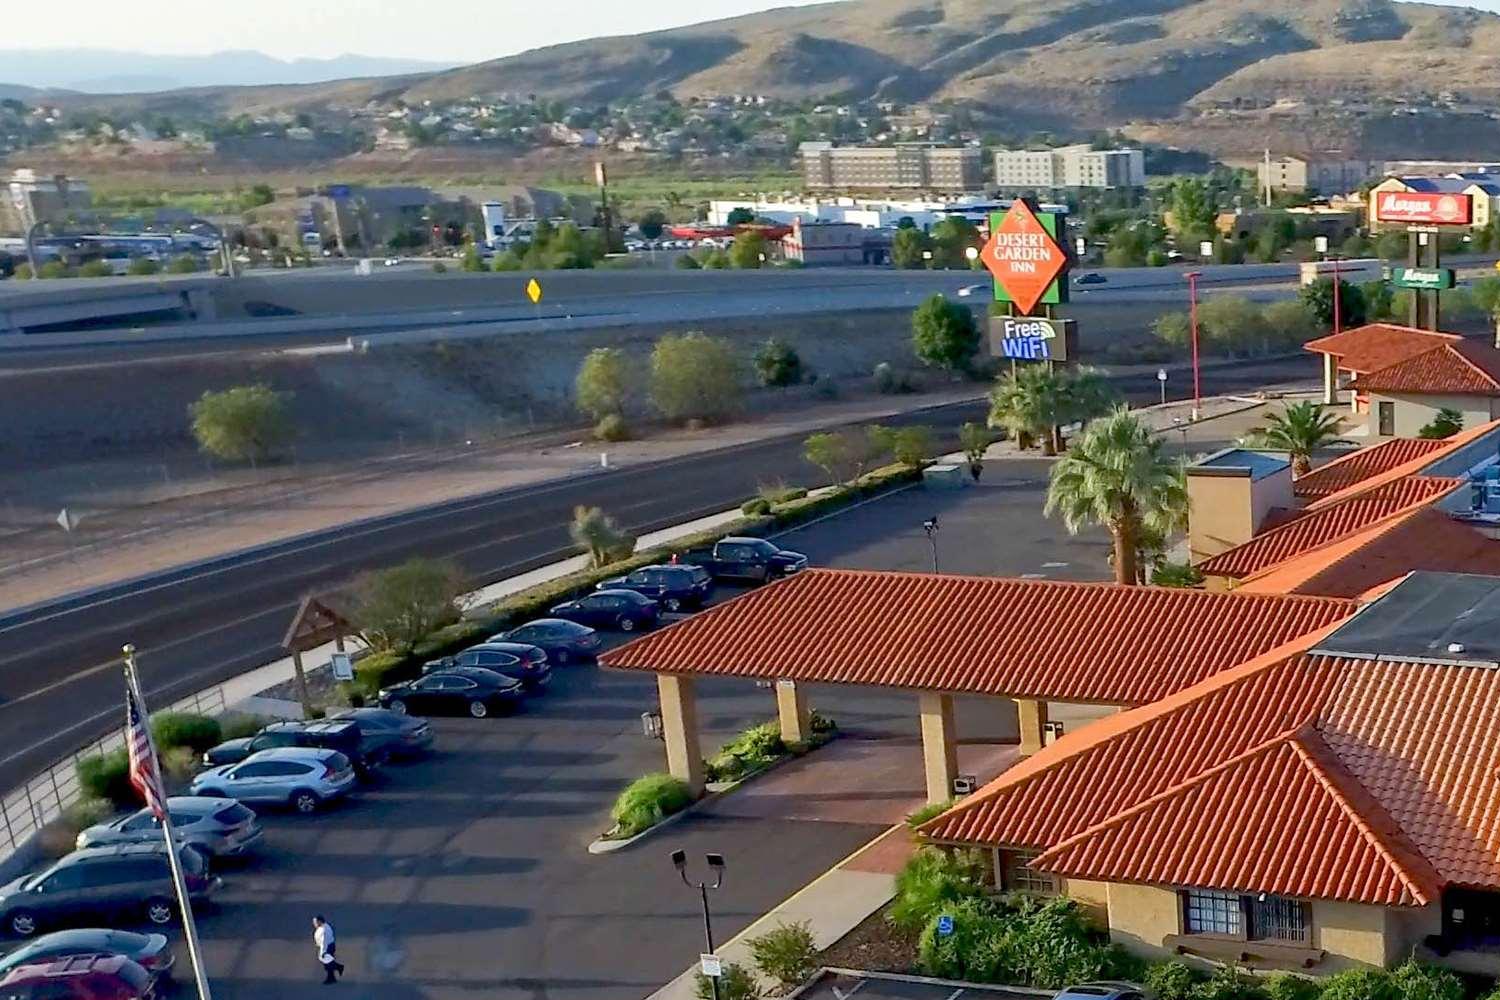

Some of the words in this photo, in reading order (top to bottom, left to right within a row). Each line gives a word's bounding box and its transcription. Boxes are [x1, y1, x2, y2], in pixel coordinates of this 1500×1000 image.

[997, 233, 1046, 248] DESERT
[994, 246, 1050, 261] GARDEN
[1011, 261, 1036, 273] INN
[1005, 321, 1040, 338] Free
[1002, 337, 1048, 359] WiFi
